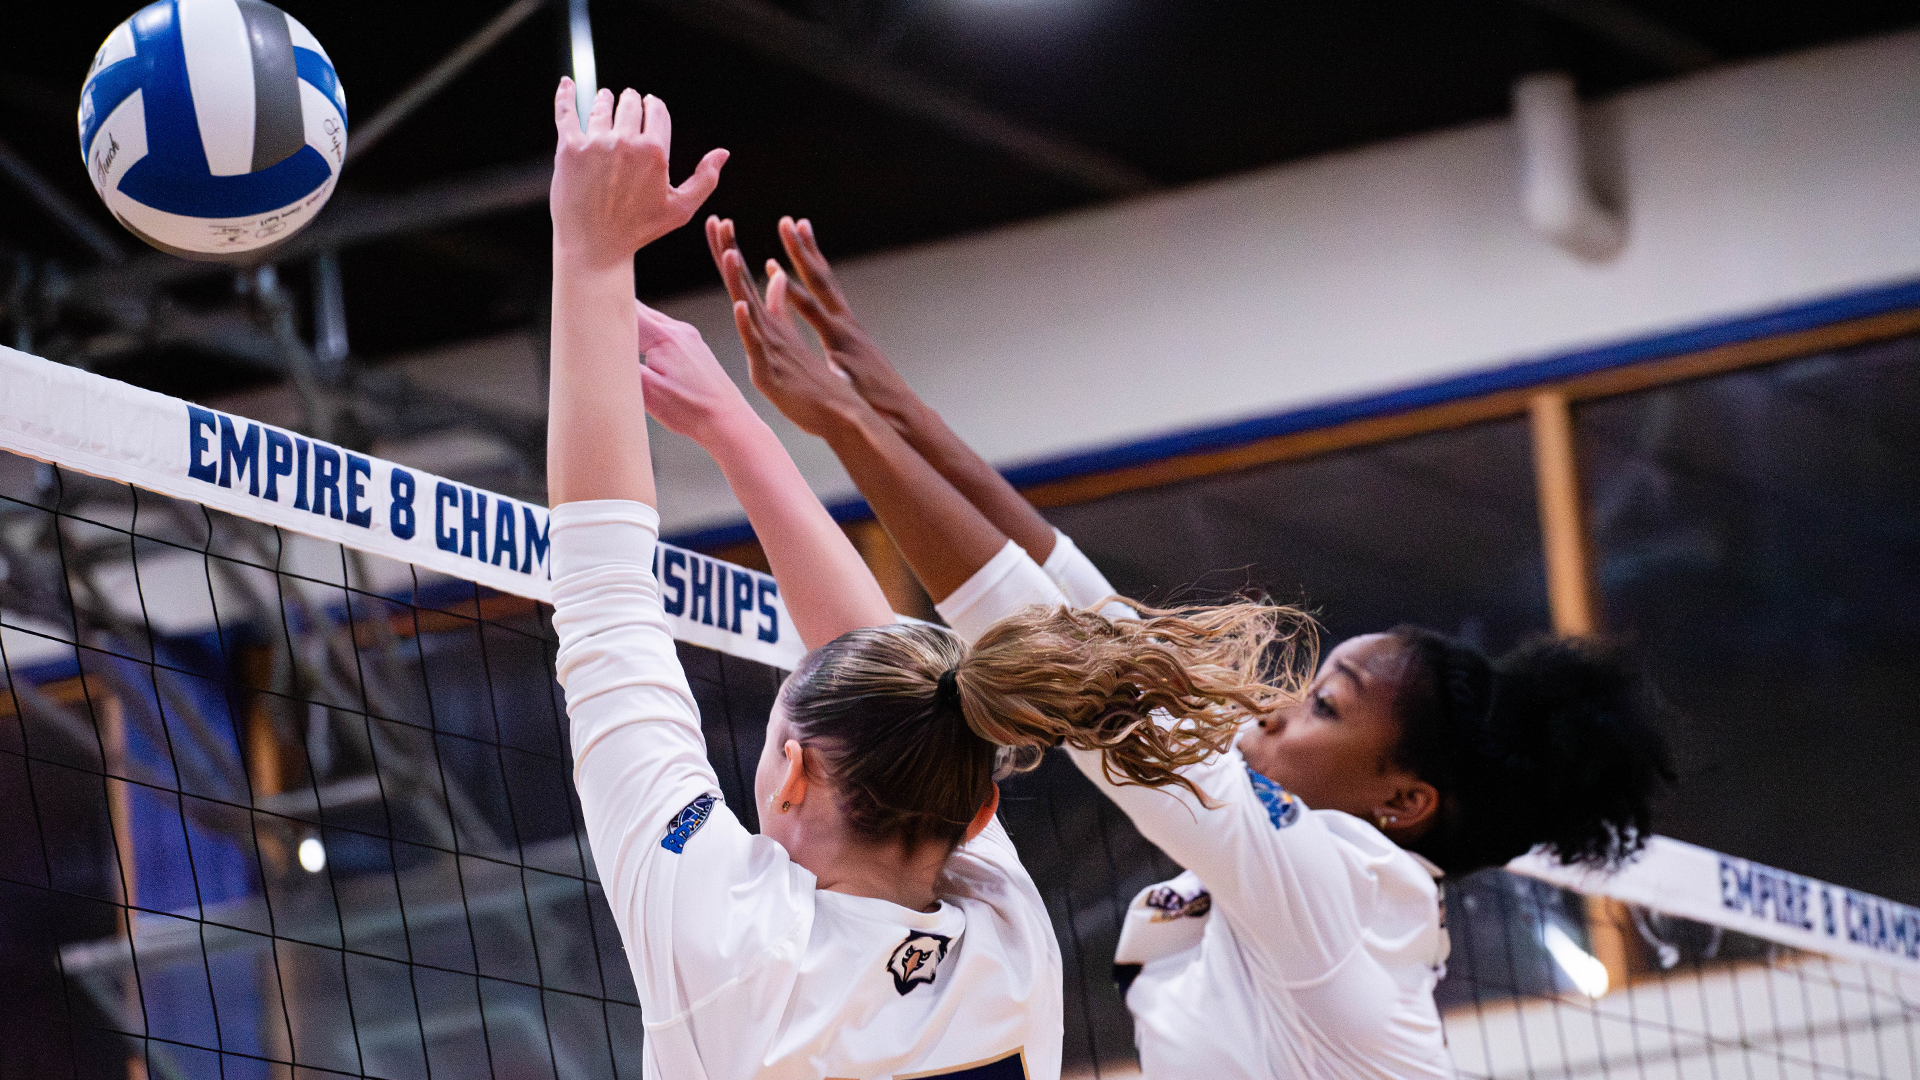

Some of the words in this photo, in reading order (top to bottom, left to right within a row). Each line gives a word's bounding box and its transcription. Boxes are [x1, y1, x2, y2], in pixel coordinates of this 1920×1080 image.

[186, 404, 372, 529] EMPIRE
[390, 467, 416, 541] 8
[435, 481, 779, 645] CHAMSHIPS
[1719, 859, 1814, 931] EMPIRE
